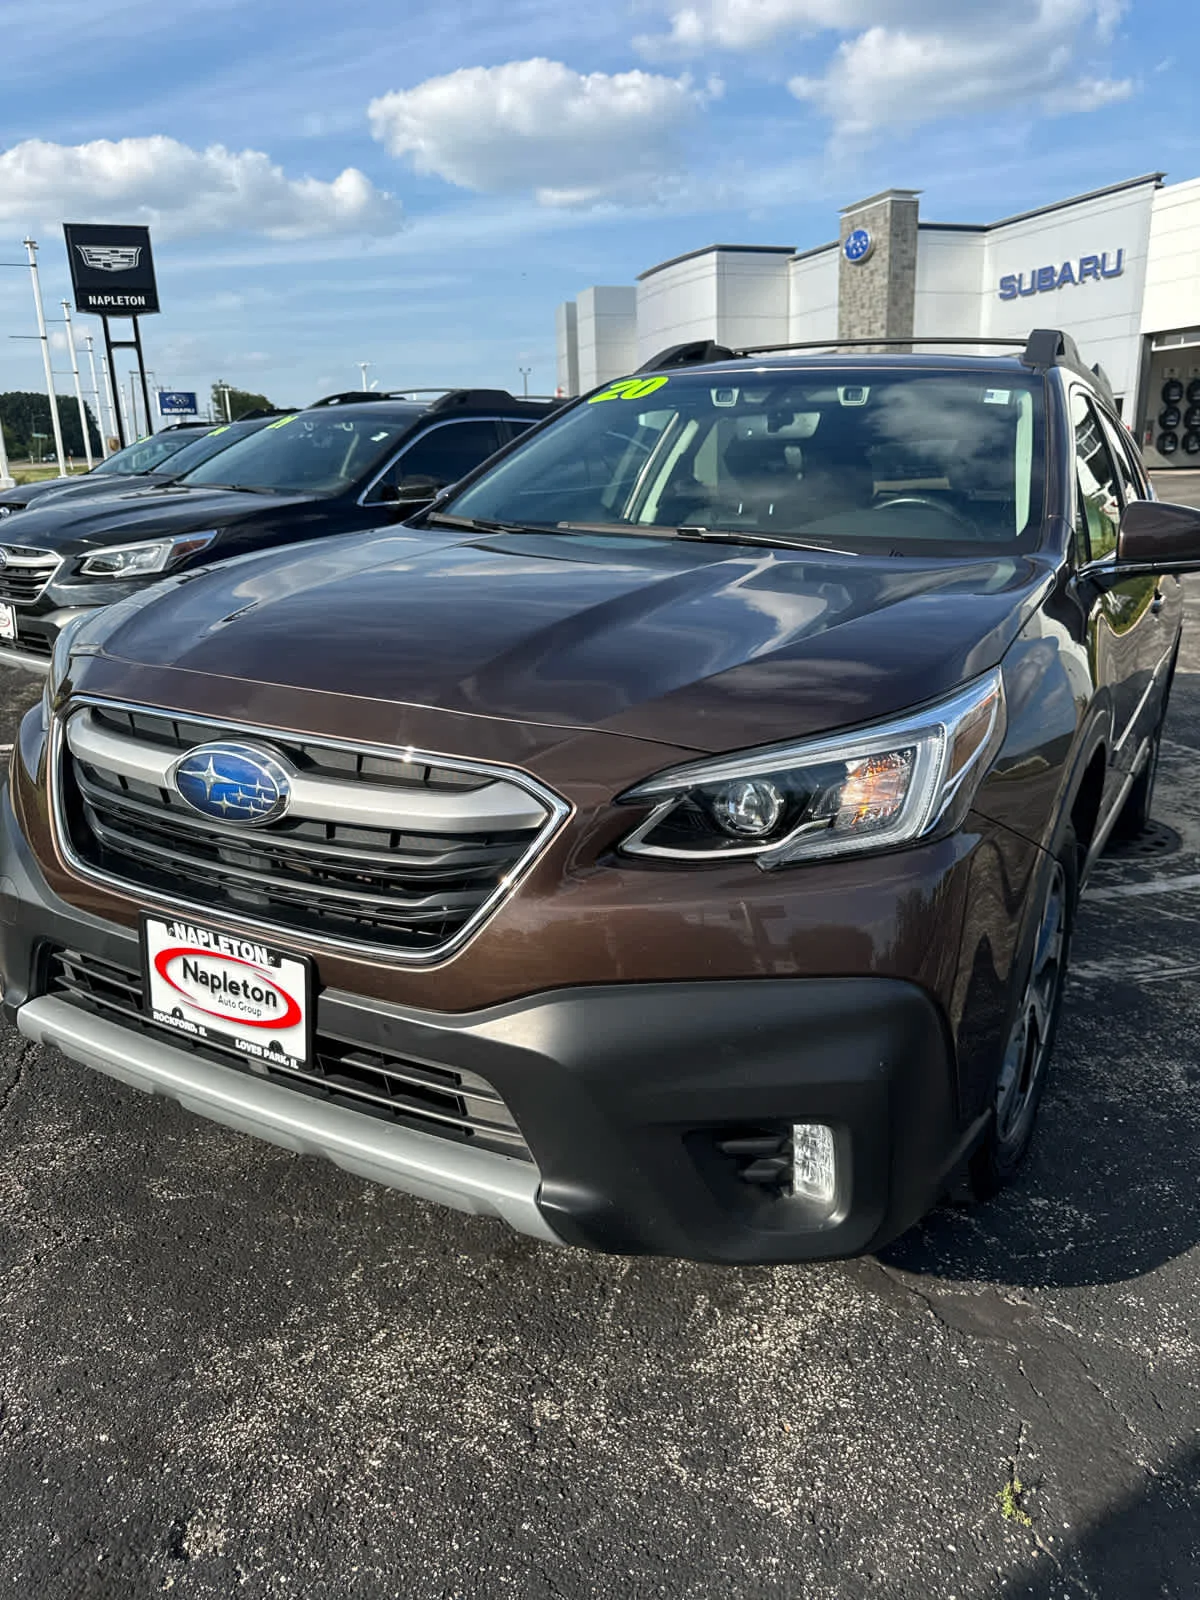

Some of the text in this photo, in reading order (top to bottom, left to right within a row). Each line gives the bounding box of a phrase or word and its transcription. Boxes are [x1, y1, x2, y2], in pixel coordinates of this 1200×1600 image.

[998, 249, 1125, 301] SUBARU
[88, 295, 146, 307] NAPLETON
[587, 376, 669, 404] 20
[162, 407, 196, 415] SUBARU
[172, 922, 269, 966] NAPLETON
[181, 957, 278, 1008] Napleton
[218, 995, 263, 1018] Auto Group
[199, 1026, 208, 1037] IL
[235, 1039, 263, 1056] LOVES
[290, 1059, 299, 1070] IL
